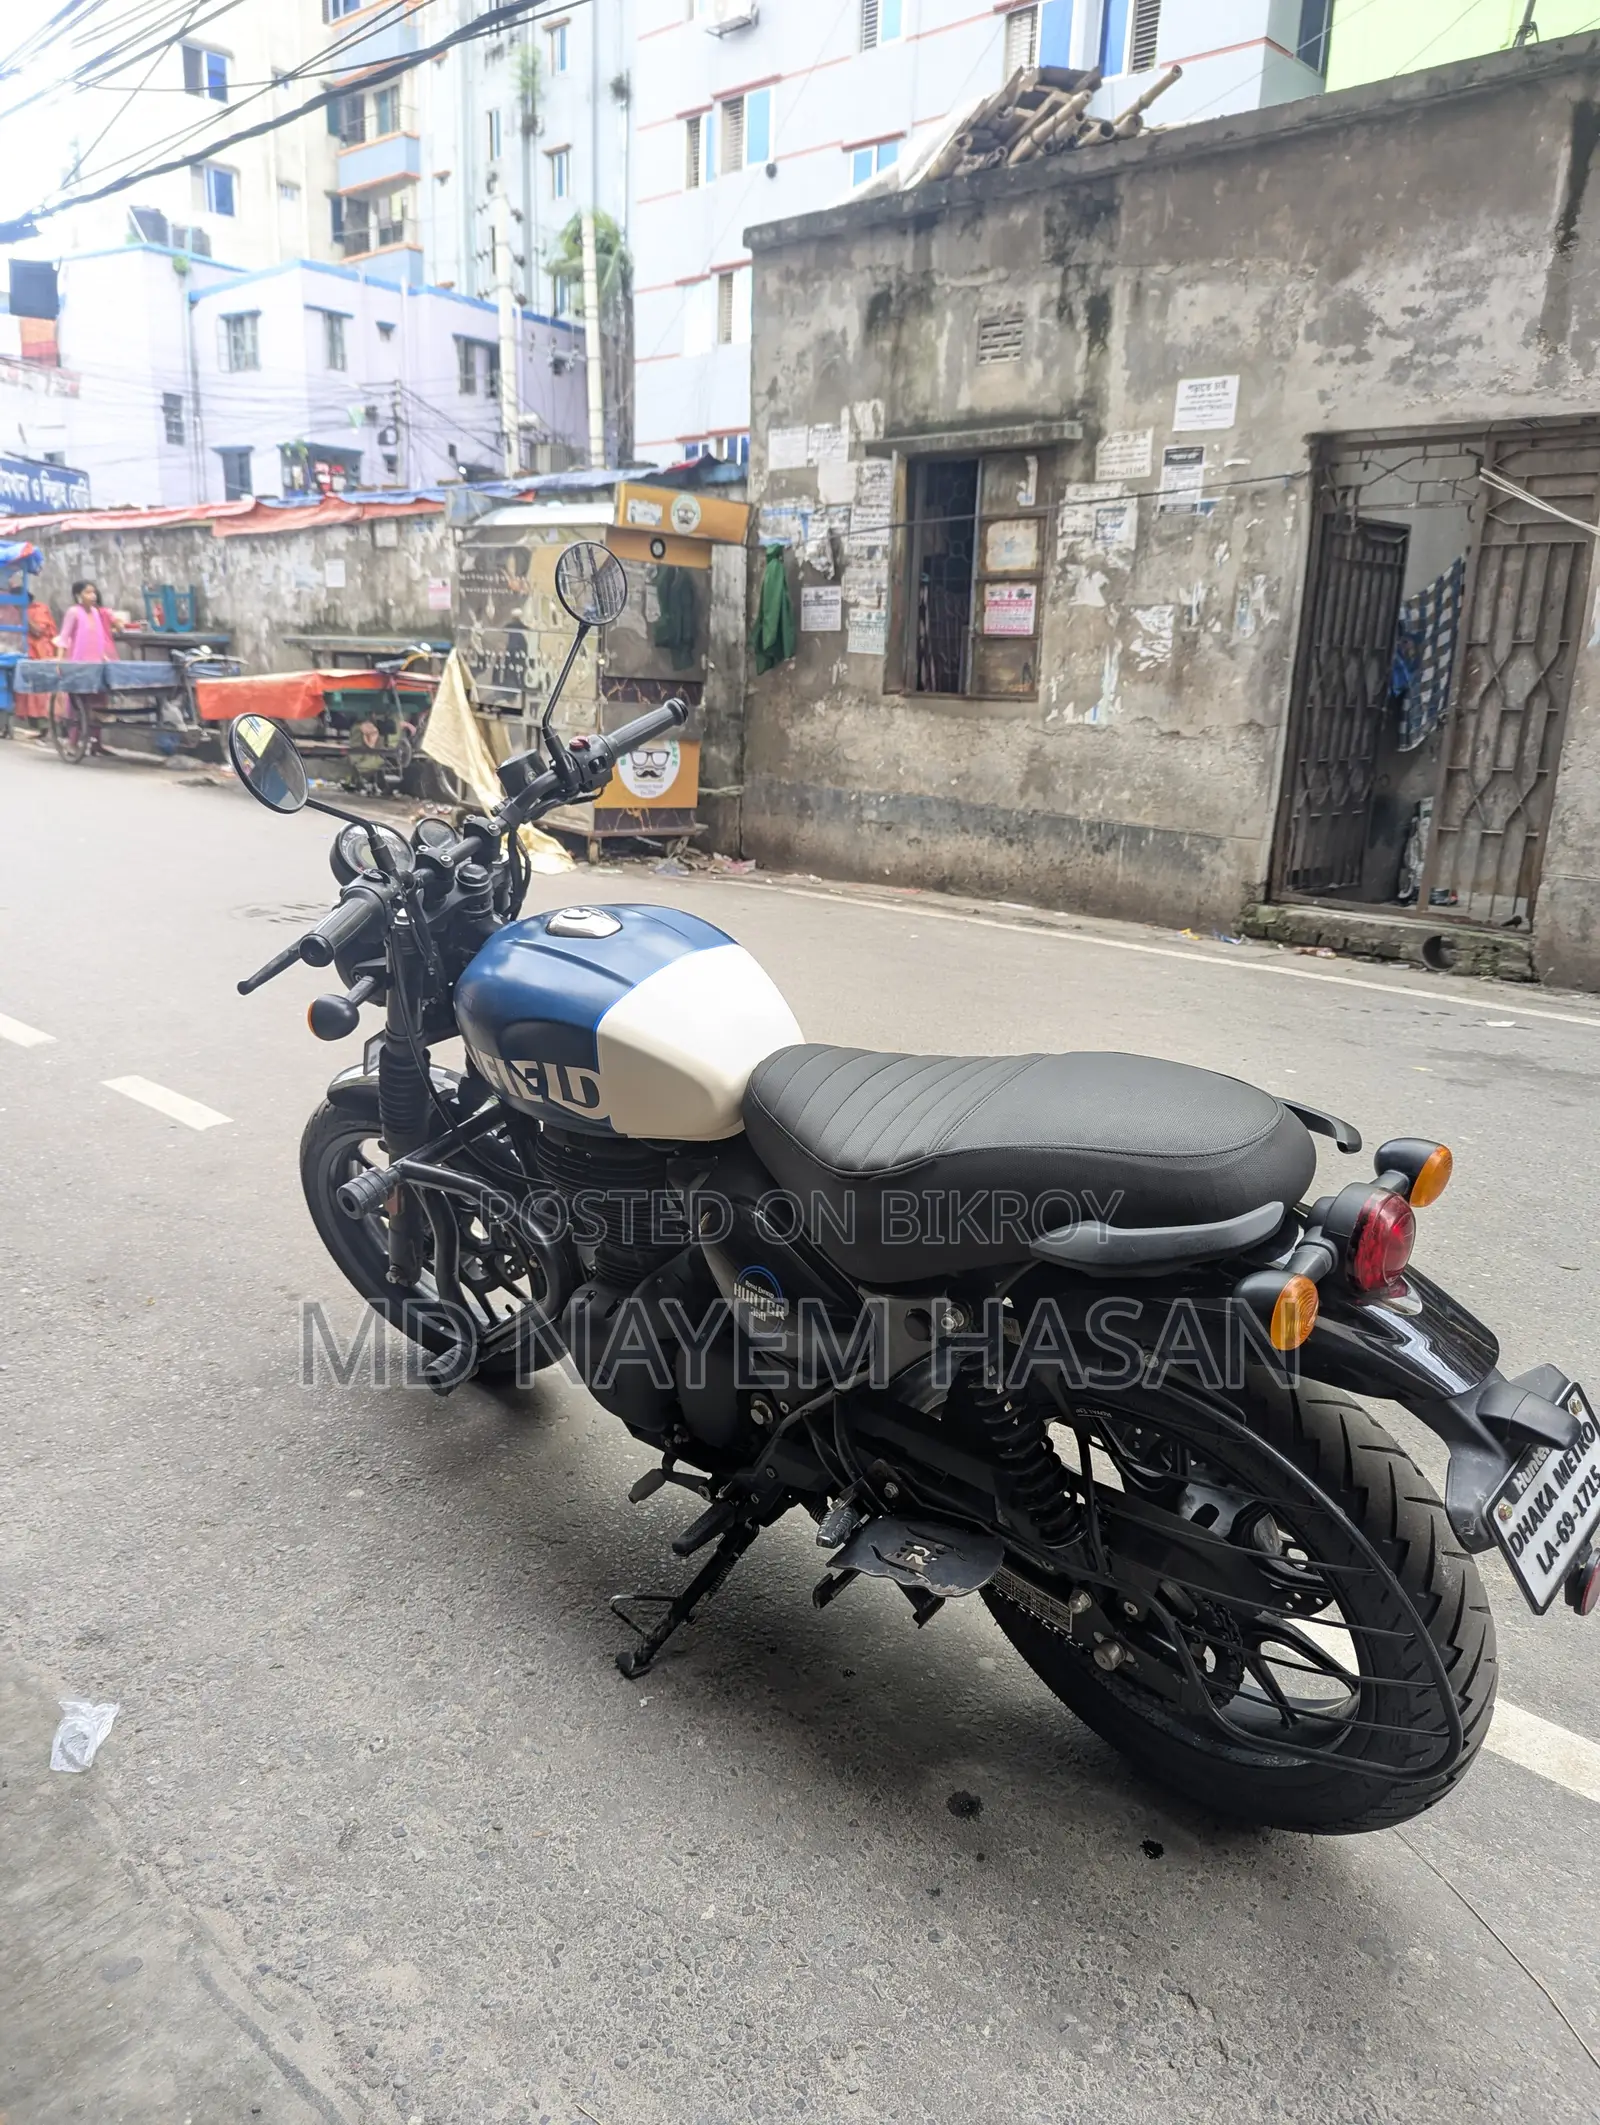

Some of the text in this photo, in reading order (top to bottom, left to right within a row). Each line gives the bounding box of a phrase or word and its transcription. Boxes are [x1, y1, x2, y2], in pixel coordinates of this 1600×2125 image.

[733, 1282, 785, 1321] HUNTER
[750, 1306, 767, 1322] 350
[1507, 1482, 1560, 1558] DHAKA
[1536, 1464, 1600, 1575] LA-69-1715
